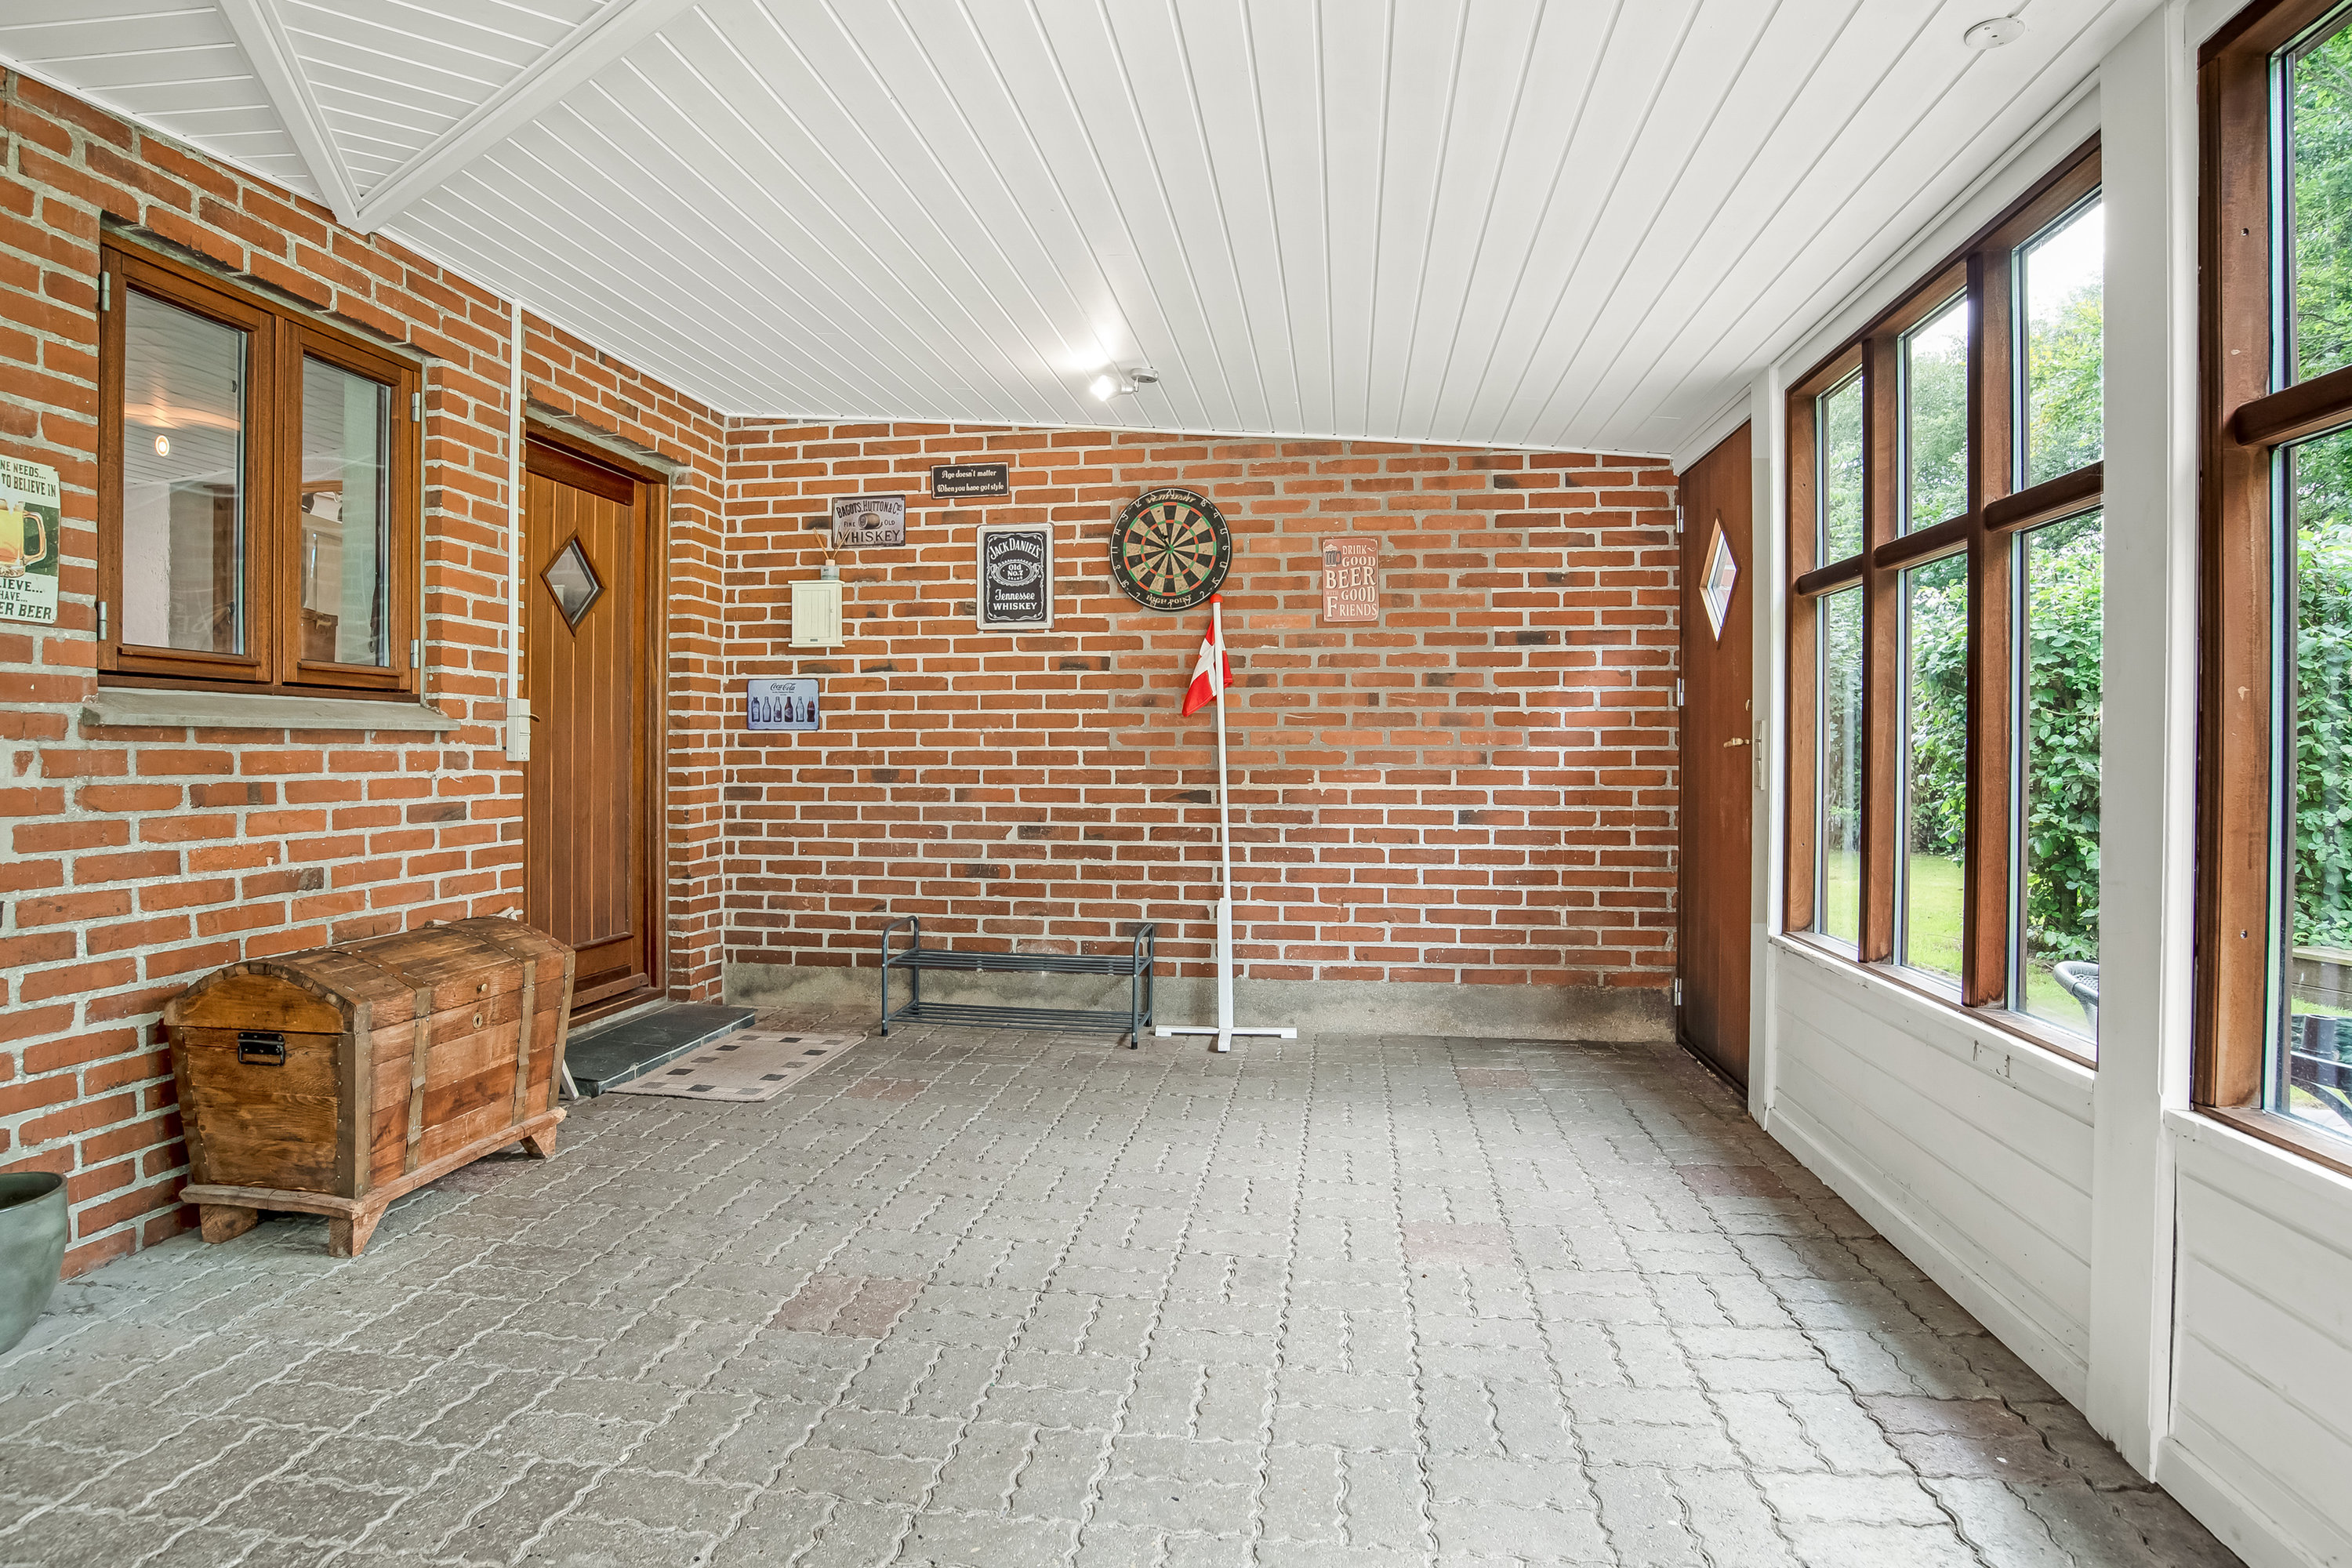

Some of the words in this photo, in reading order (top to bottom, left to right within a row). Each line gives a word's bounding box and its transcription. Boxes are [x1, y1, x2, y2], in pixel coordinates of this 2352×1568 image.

[13, 463, 46, 480] NEEDS...
[942, 470, 955, 479] Age
[955, 469, 976, 477] doesn't
[2, 473, 11, 488] TO
[13, 476, 45, 495] BELIEVE
[47, 483, 56, 498] IN
[936, 484, 955, 492] When
[966, 483, 980, 492] have
[990, 481, 1004, 492] style
[838, 530, 901, 543] WHISKEY
[989, 541, 1009, 560] JACK
[1341, 556, 1377, 568] GOOD
[1325, 566, 1377, 589] BEER
[994, 589, 1036, 601] Tennessee
[1341, 586, 1376, 603] GOOD
[993, 602, 1038, 611] WHISKEY
[1326, 596, 1377, 618] FRIENDS
